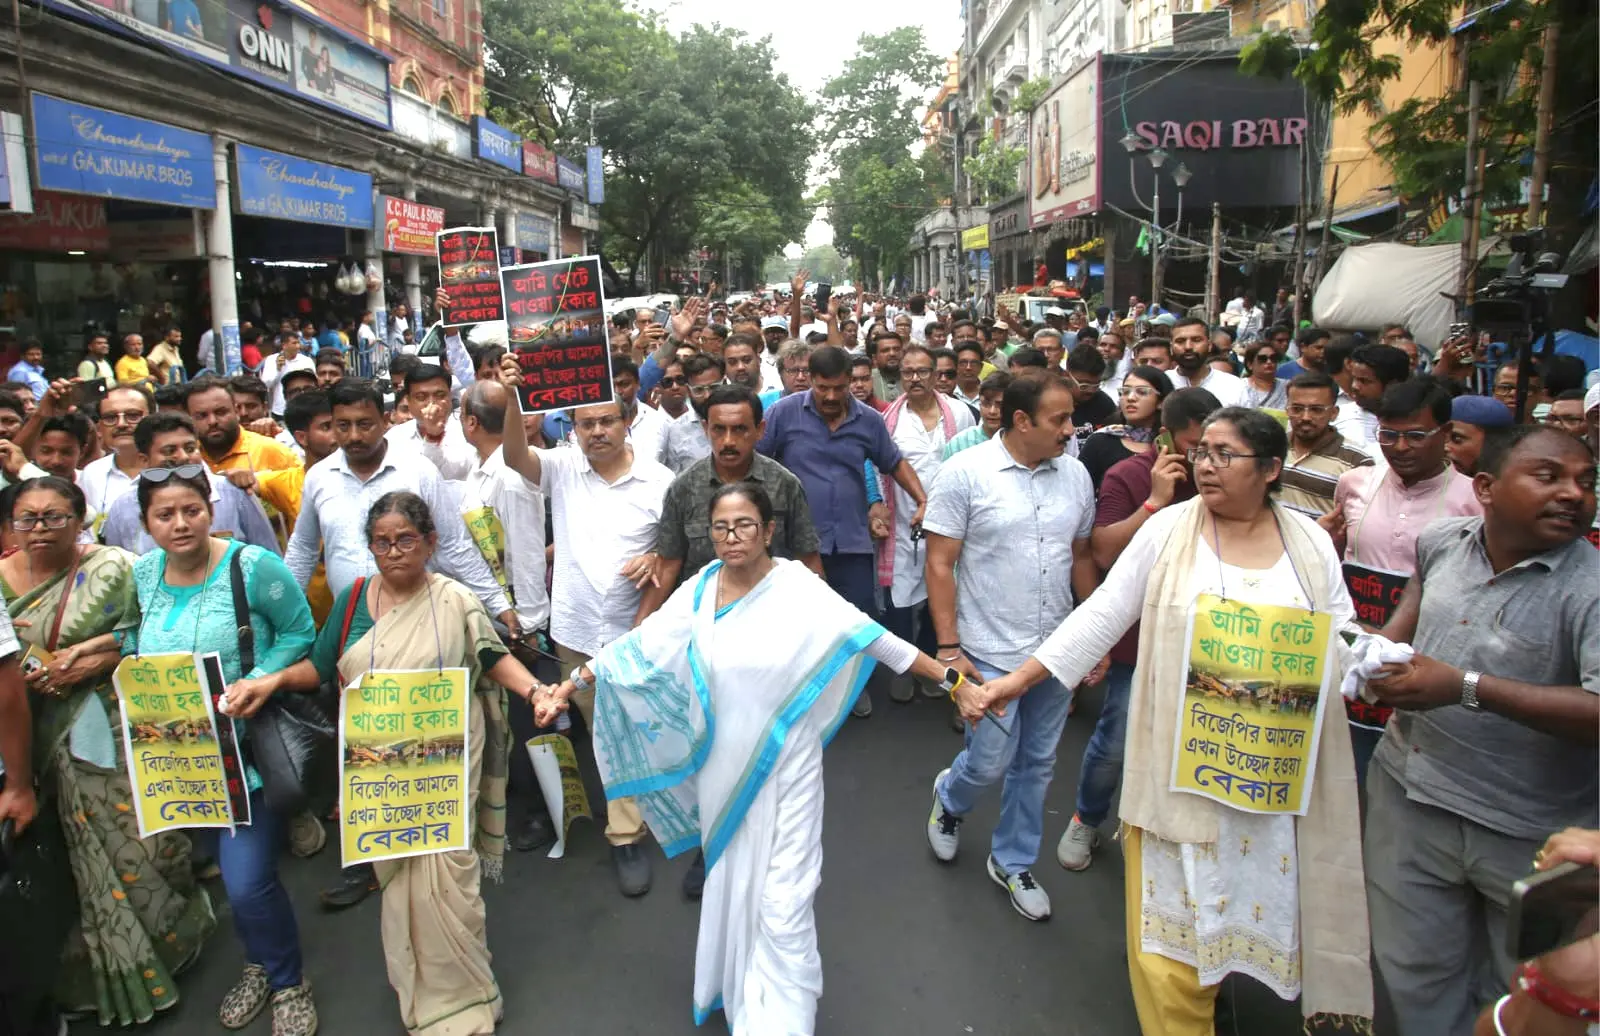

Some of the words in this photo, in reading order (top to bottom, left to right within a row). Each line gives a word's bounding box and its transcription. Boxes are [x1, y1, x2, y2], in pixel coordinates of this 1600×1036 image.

[239, 24, 291, 72] ONN
[1135, 120, 1221, 151] SAQI
[1232, 117, 1307, 148] BAR
[73, 150, 156, 181] GAJKUMAR
[159, 165, 193, 187] BROS
[260, 157, 355, 200] Chandralaya
[324, 202, 346, 223] BROS
[403, 203, 420, 221] PAUL
[426, 208, 444, 224] SONS
[512, 270, 546, 293] আমি
[552, 267, 589, 291] খেটে
[509, 295, 553, 316] খাওয়া
[556, 291, 597, 312] হকার
[566, 345, 603, 361] আমলে
[579, 364, 606, 381] হওয়া
[529, 383, 601, 408] বেকার
[1350, 575, 1384, 599] আমি
[1209, 606, 1262, 640] আমি
[1270, 619, 1315, 646] খেটে
[1199, 637, 1264, 671] খাওয়া
[1270, 651, 1317, 676] হকার
[359, 679, 401, 705] আমি
[409, 679, 453, 705] খেটে
[351, 711, 406, 732] খাওয়া
[412, 707, 459, 732] হকার
[1191, 702, 1261, 745] বিজেপির
[1265, 726, 1306, 749] আমলে
[1185, 737, 1220, 761] এখন
[1224, 742, 1271, 776] উচ্ছেদ
[1273, 757, 1302, 778] হওয়া
[145, 780, 174, 797] এখন
[349, 774, 410, 800] বিজেপির
[414, 774, 459, 795] আমলে
[1194, 764, 1290, 805] বেকার
[347, 806, 378, 826] এখন
[381, 803, 424, 826] উচ্ছেদ
[426, 799, 459, 817] হওয়া
[357, 822, 451, 852] বেকার
